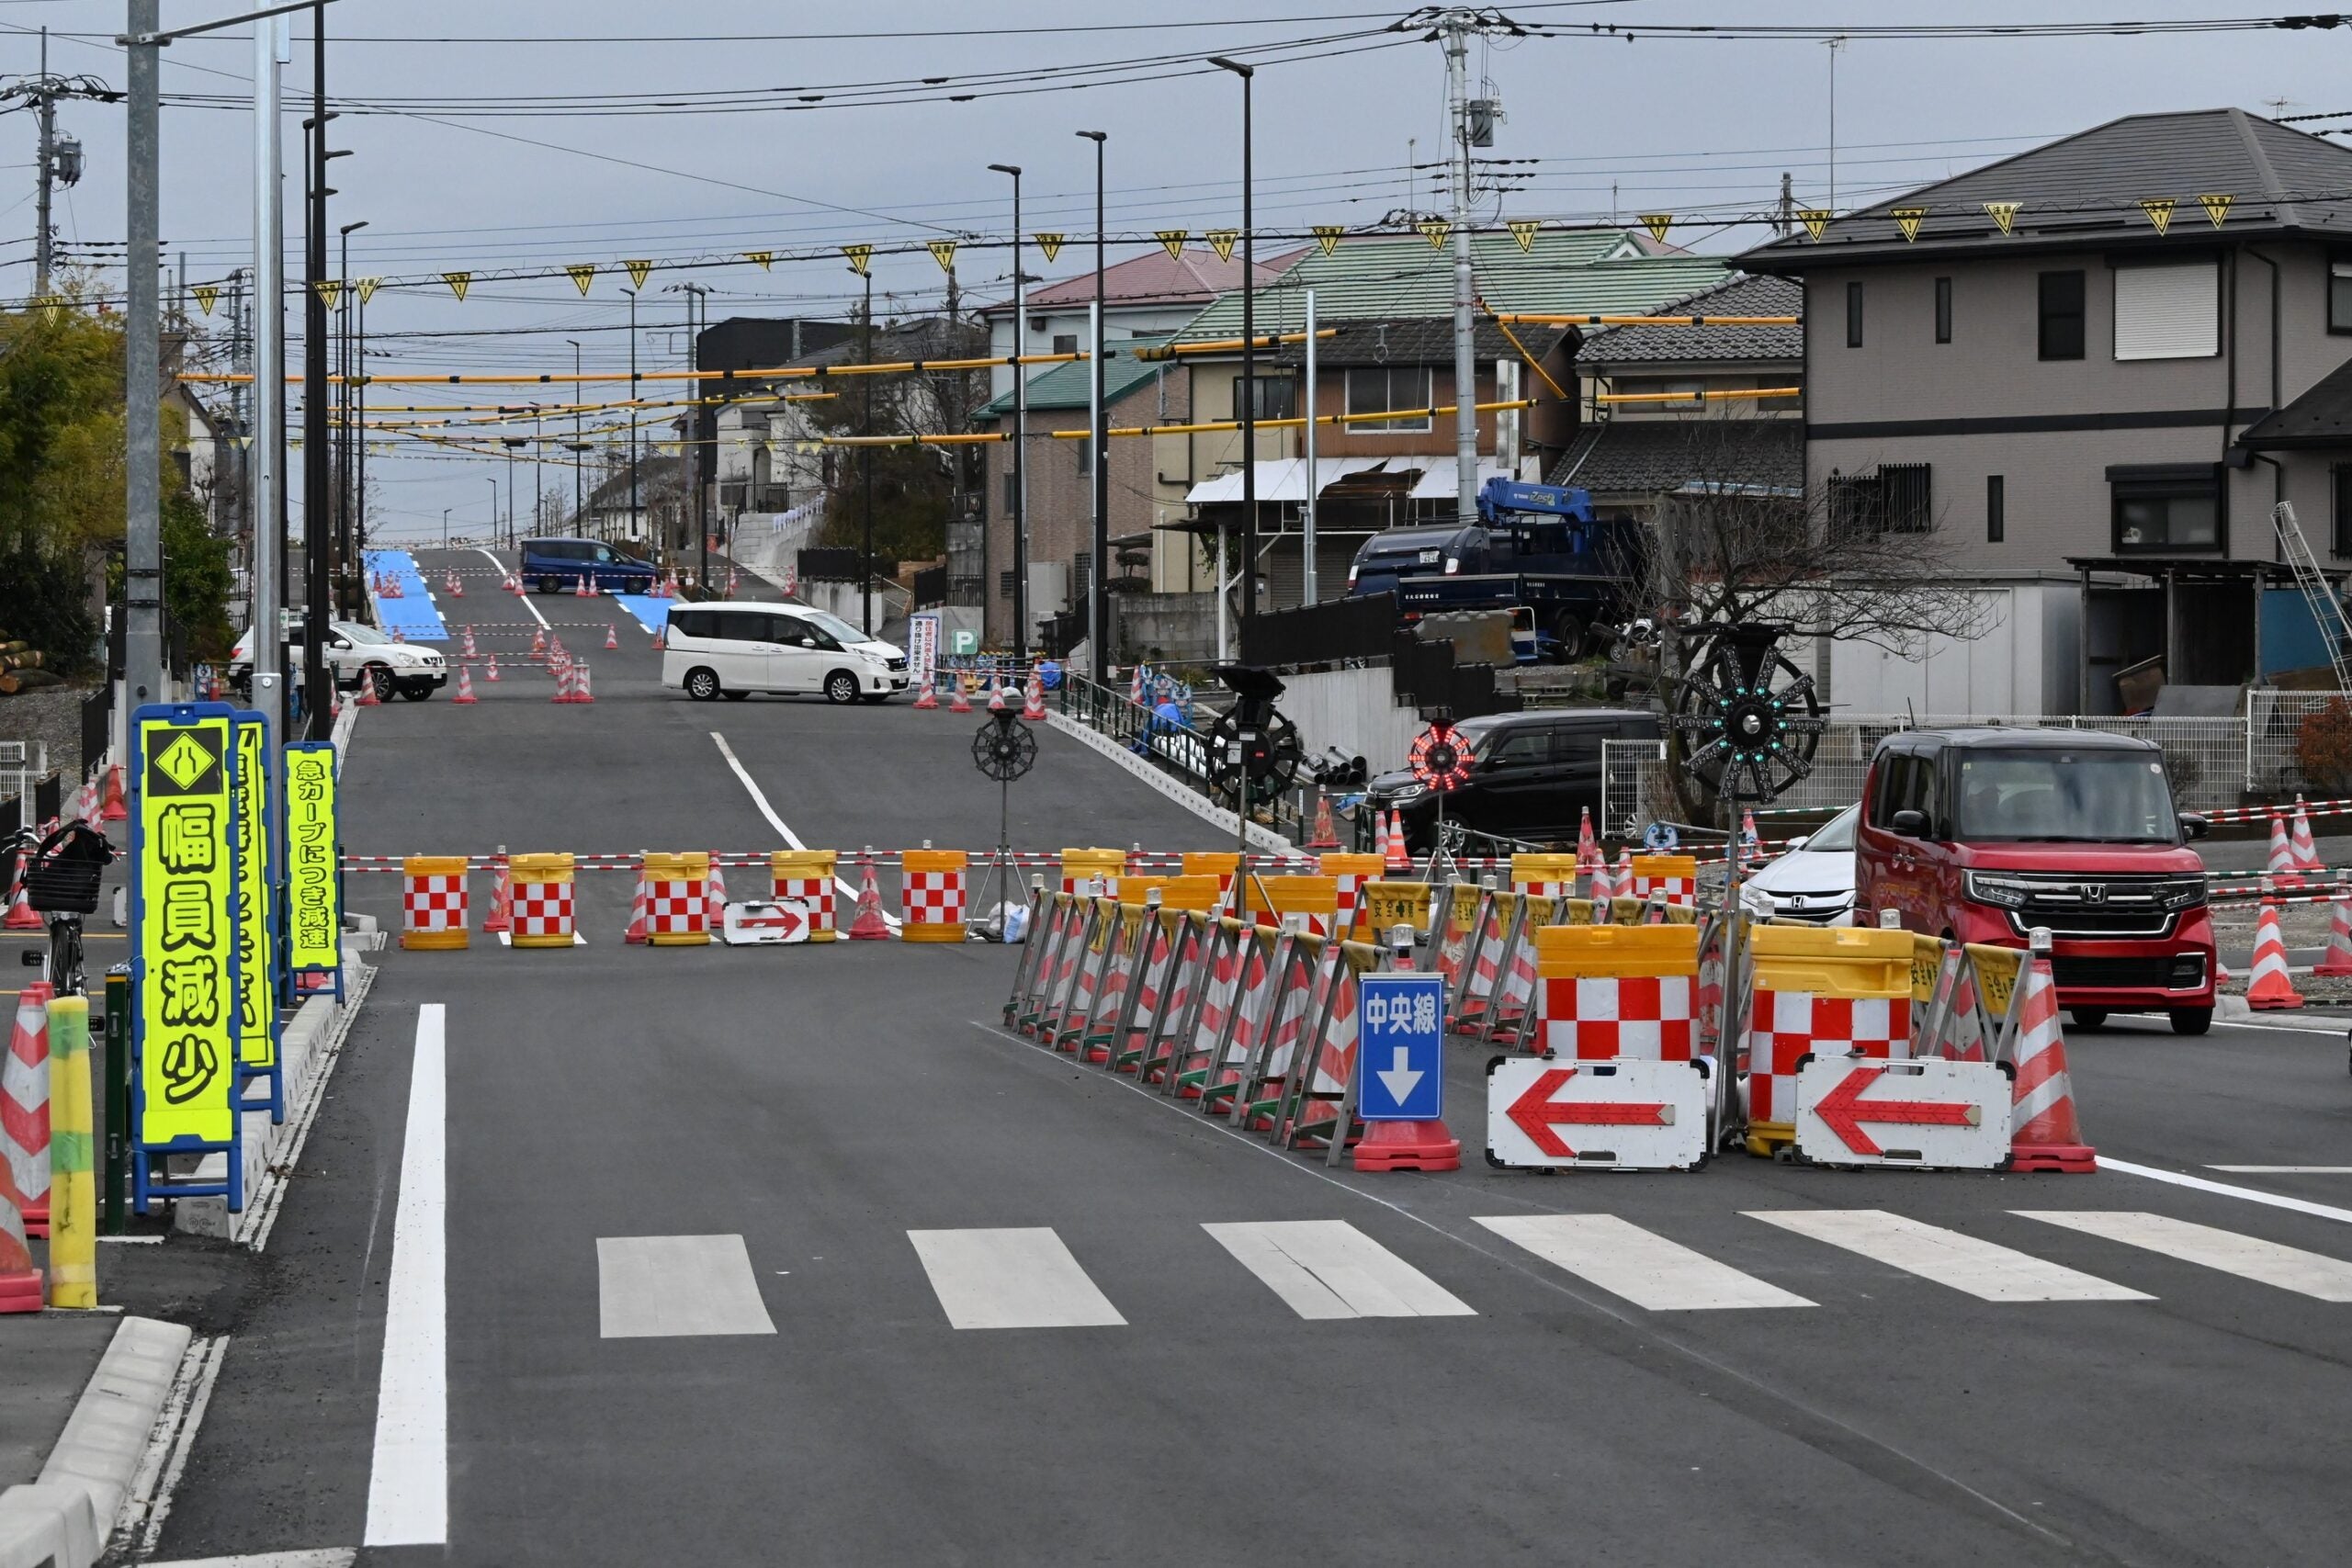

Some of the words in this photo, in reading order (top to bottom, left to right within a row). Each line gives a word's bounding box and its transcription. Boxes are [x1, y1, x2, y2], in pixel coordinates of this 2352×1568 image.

[1993, 206, 2011, 214] 注意
[956, 631, 973, 653] P
[296, 760, 330, 950] 急カーブにつき減速
[158, 803, 219, 1104] 幅員減少
[1366, 991, 1437, 1035] 中央線
